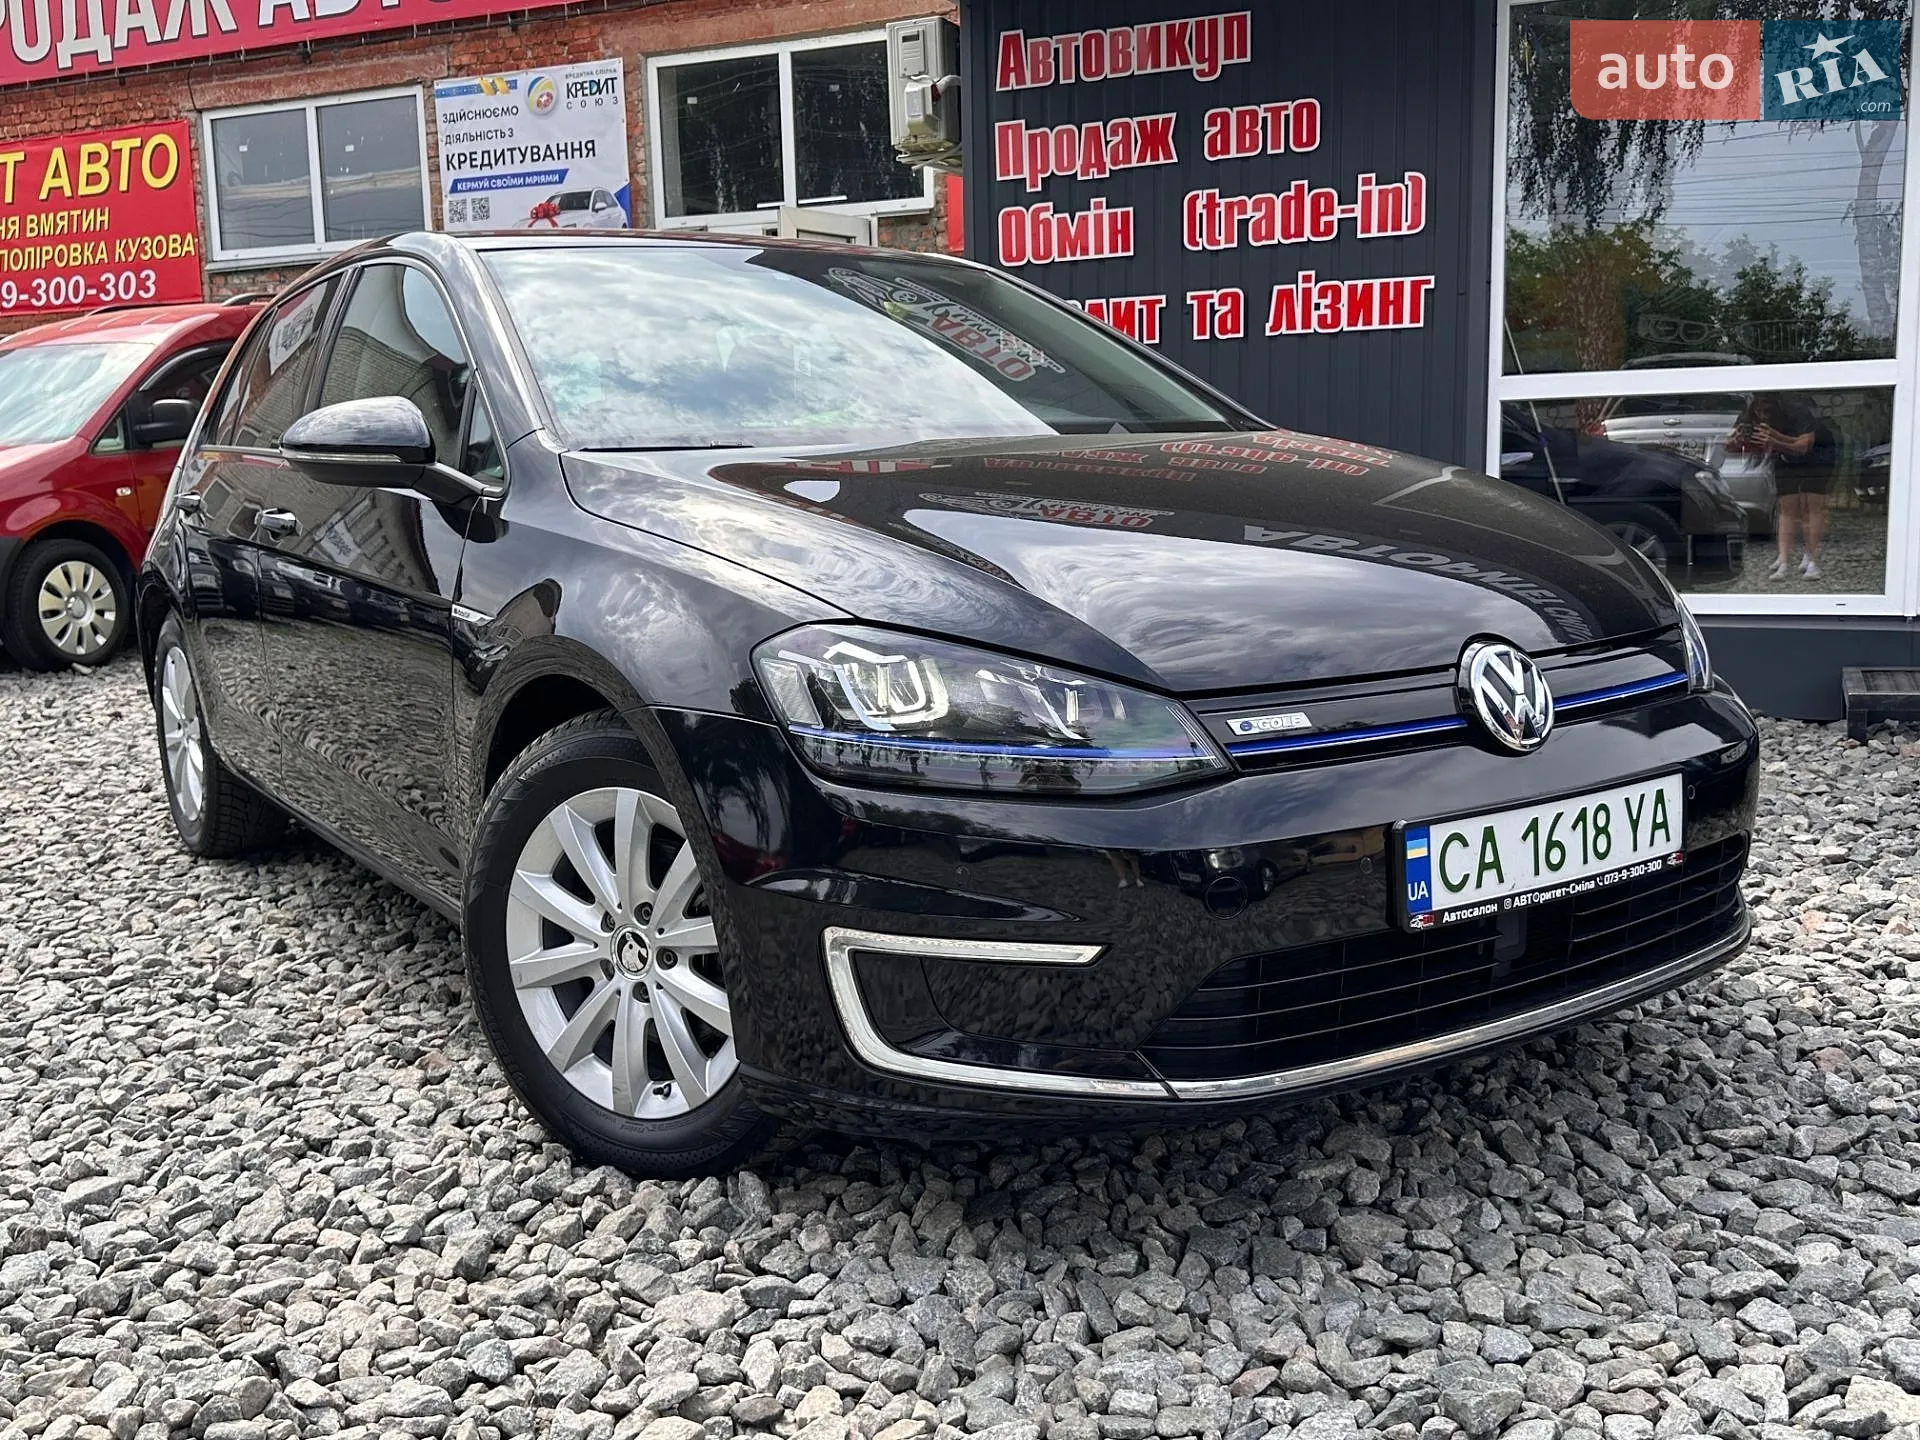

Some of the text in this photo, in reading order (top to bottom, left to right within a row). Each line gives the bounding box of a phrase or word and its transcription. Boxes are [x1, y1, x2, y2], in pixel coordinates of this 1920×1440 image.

[996, 11, 1252, 92] Автовикуп
[442, 105, 519, 124] ЗДІЙСНЮЄМО
[444, 129, 506, 146] ДІЯЛЬНІСТЬ
[446, 139, 596, 171] КРЕДИТУВАННЯ
[995, 98, 1320, 192] Продаж авто
[39, 133, 178, 200] АВТО
[457, 173, 560, 191] КЕРМУЙ СВОЇМИ МРІЯМИ
[26, 207, 110, 238] ВМЯТИН
[999, 171, 1426, 267] Обмін (trade-in)
[115, 233, 196, 263] КУЗОВА
[1, 269, 157, 308] 9-300-303
[1187, 288, 1244, 340] та
[1266, 270, 1434, 336] лізинг
[1439, 788, 1671, 893] CA 1618 YA
[1408, 880, 1429, 901] UA
[1442, 904, 1497, 923] Автосалон
[1604, 860, 1662, 885] 073-9-300-300
